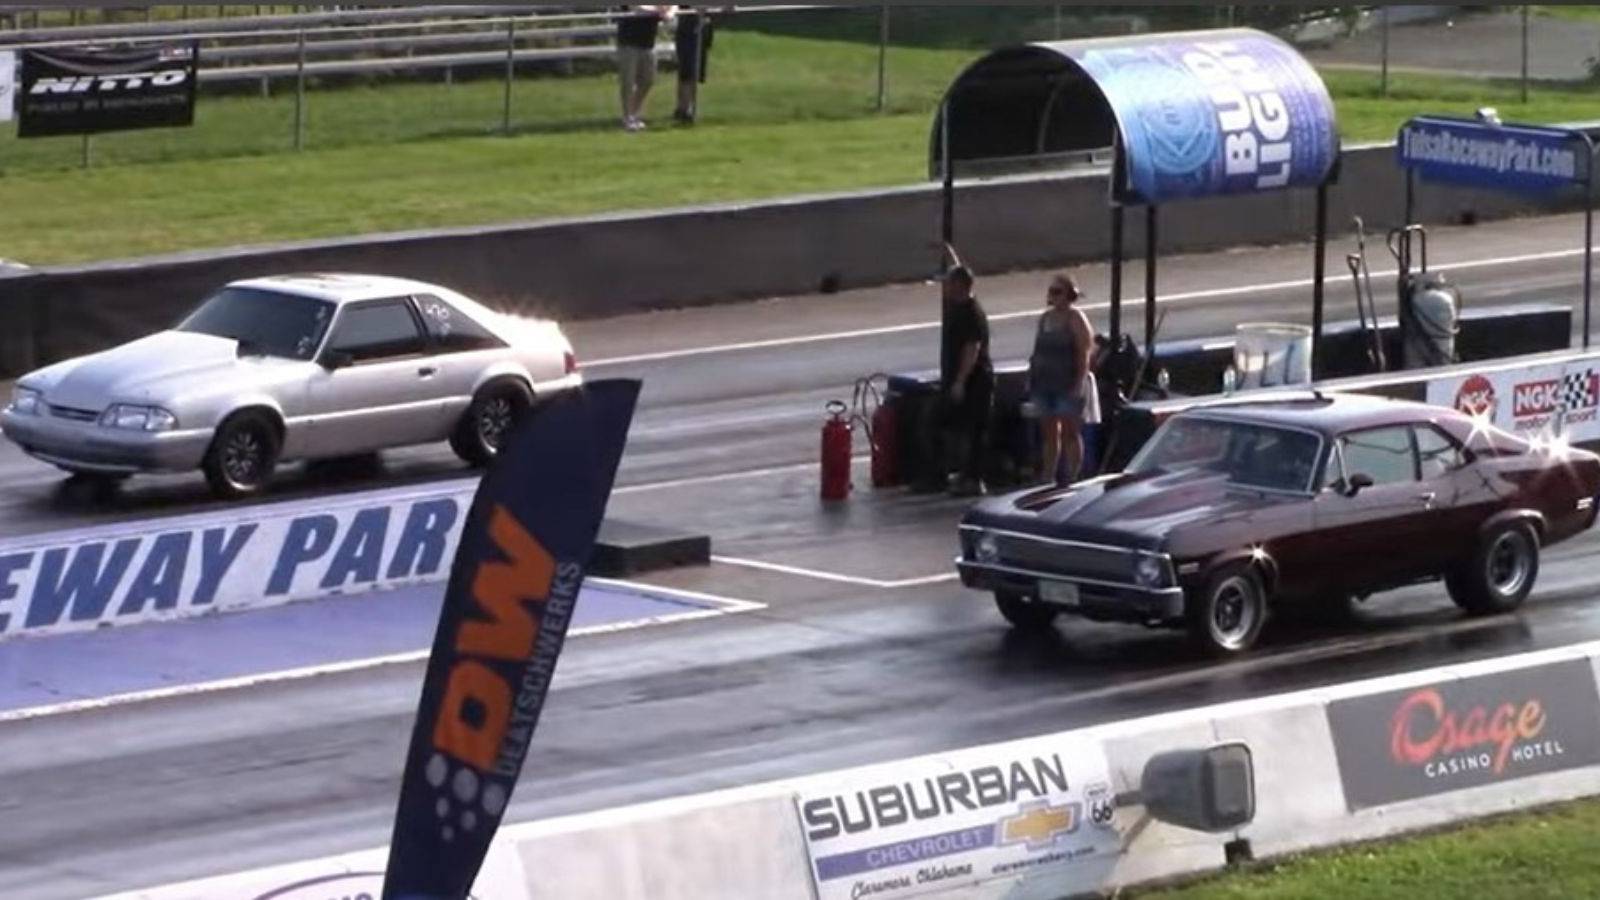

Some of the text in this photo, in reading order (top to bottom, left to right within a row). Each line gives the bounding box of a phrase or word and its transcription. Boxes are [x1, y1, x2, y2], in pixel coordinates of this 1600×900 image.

[29, 69, 187, 94] NITTO
[1183, 52, 1259, 176] BUD
[1195, 42, 1292, 189] LIGHT
[1460, 388, 1496, 412] NGK
[1514, 383, 1562, 413] NGK
[431, 503, 557, 773] DW
[497, 561, 581, 777] DEATSCHWERKS
[1391, 688, 1547, 776] Osage
[1425, 741, 1564, 778] CASINO HOTEL
[803, 753, 1068, 841] SUBURBAN
[1092, 800, 1113, 823] 66
[866, 829, 985, 867] CHEVROLET
[917, 864, 973, 884] Oklahoma
